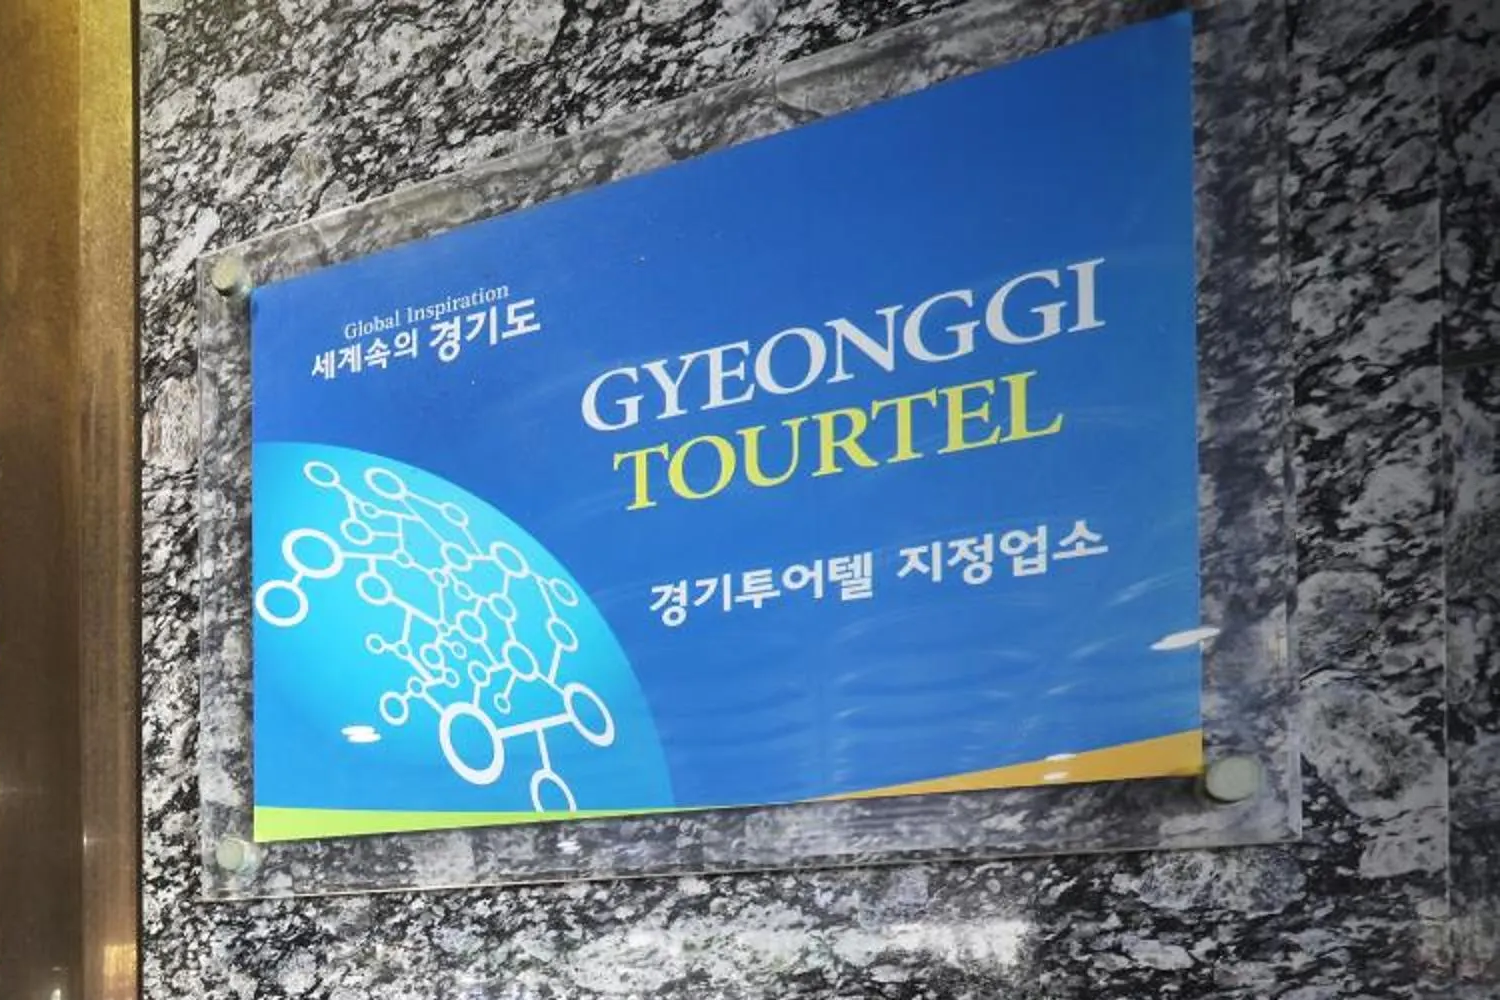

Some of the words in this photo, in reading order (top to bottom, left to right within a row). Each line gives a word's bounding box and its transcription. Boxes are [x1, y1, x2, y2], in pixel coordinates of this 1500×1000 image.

[311, 329, 419, 381] 세계속의
[429, 298, 542, 363] 경기도
[344, 309, 401, 340] Global
[406, 284, 510, 325] Inspiration
[581, 257, 1106, 432] GYEONGGI
[613, 370, 1065, 511] TOURTEL
[649, 551, 874, 627] 경기투어텔
[896, 519, 1109, 585] 지정업소
